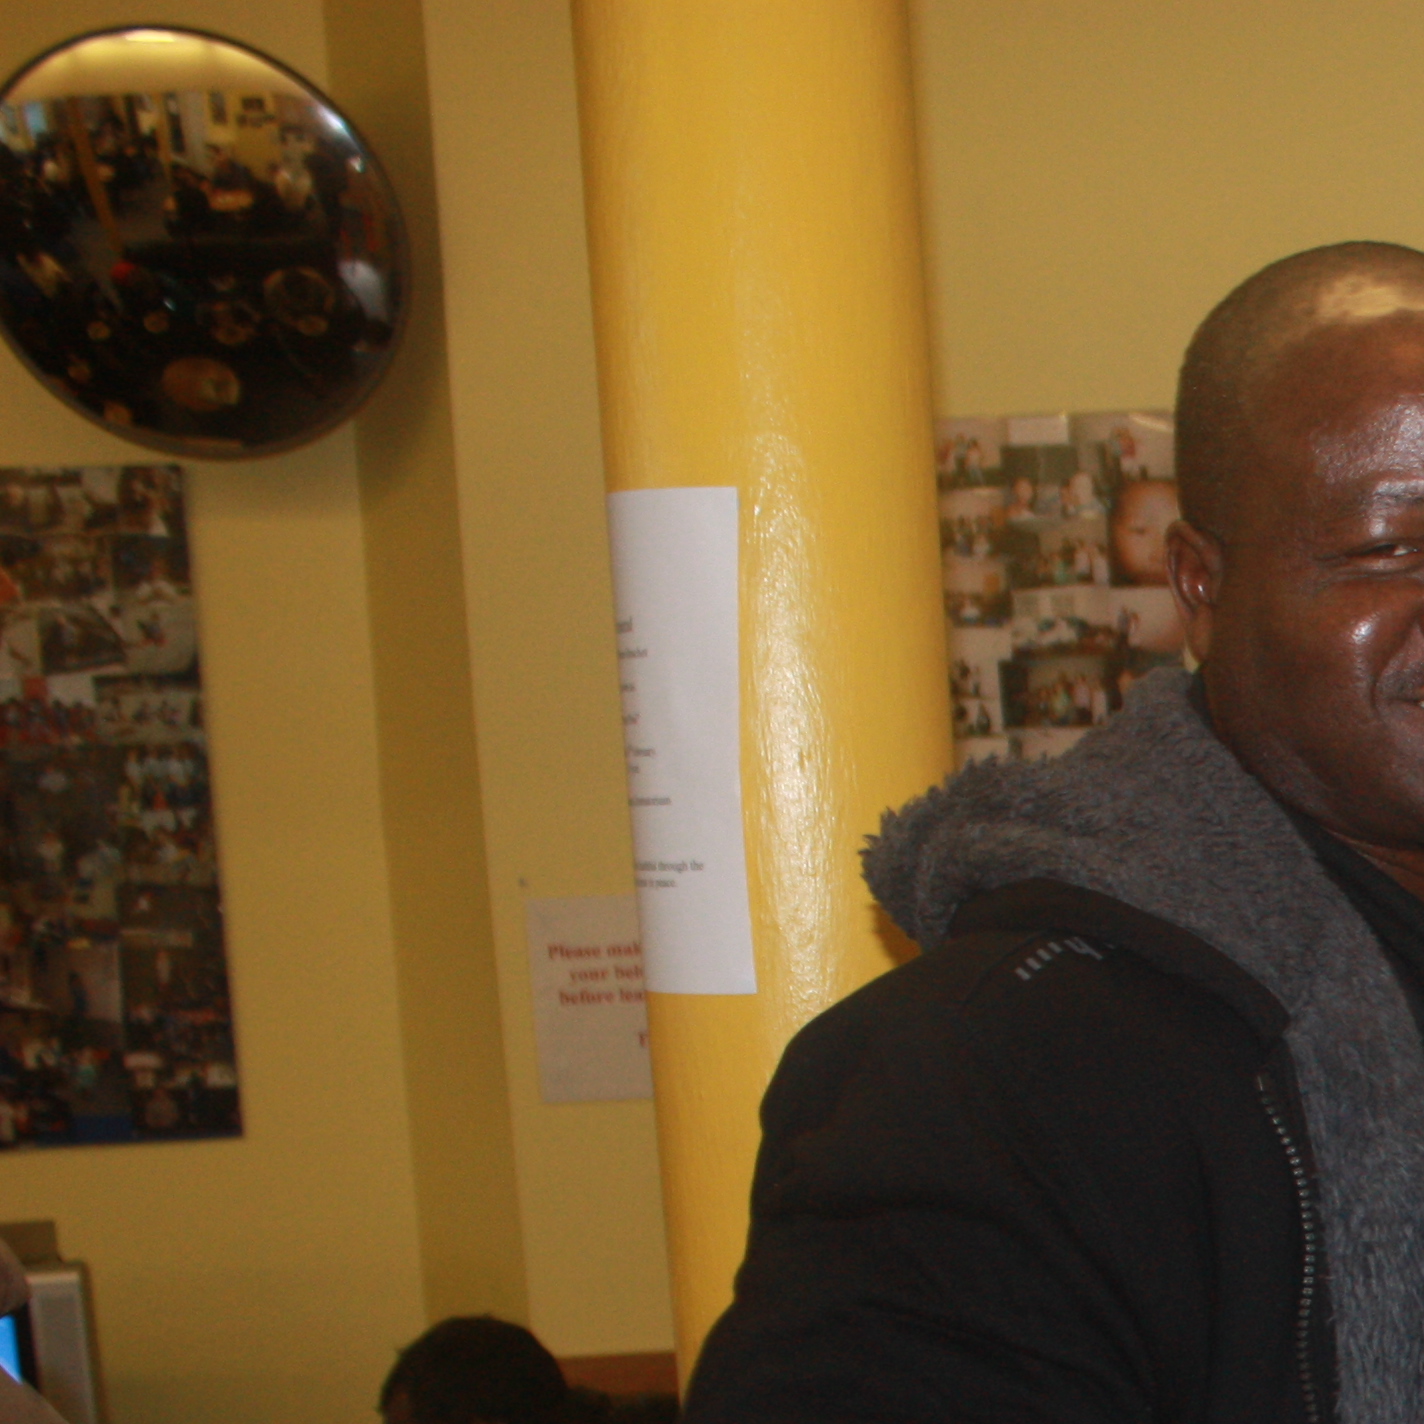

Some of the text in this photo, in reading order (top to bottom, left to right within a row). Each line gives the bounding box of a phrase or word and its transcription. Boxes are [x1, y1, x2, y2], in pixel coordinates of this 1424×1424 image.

[547, 941, 642, 960] Please mak
[569, 968, 609, 985] your
[558, 988, 645, 1005] before lea
